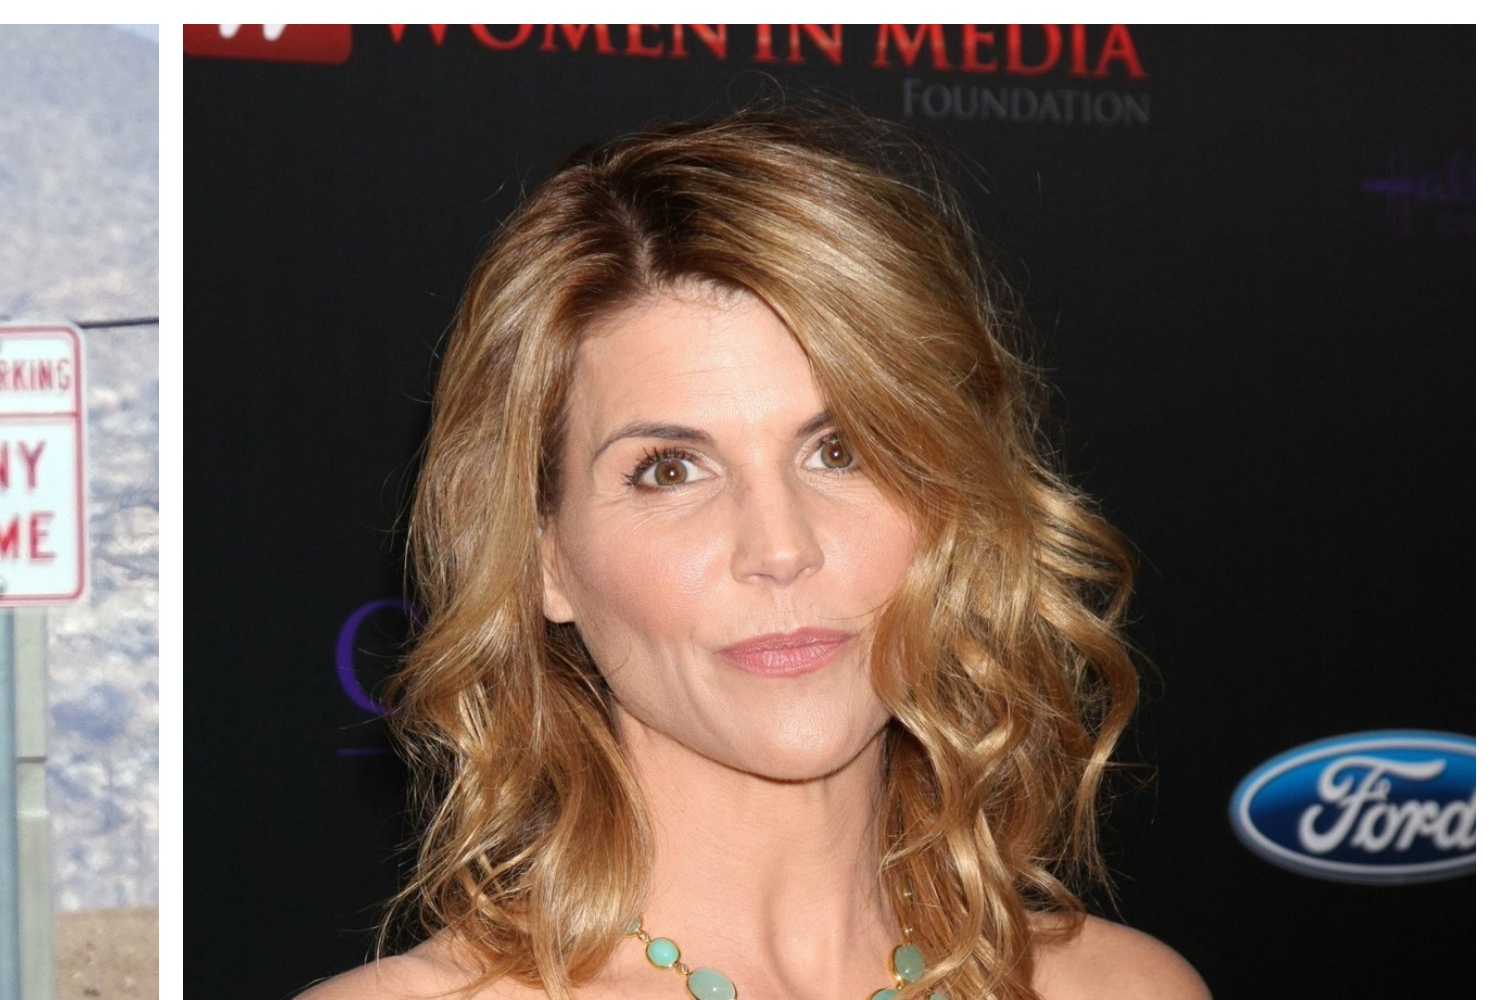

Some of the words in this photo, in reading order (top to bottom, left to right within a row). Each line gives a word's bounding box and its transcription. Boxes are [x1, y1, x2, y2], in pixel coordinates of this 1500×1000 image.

[754, 24, 843, 67] IN
[873, 24, 1149, 79] MEDIA
[902, 78, 1151, 125] FOUNDATION
[1298, 755, 1475, 853] Ford
